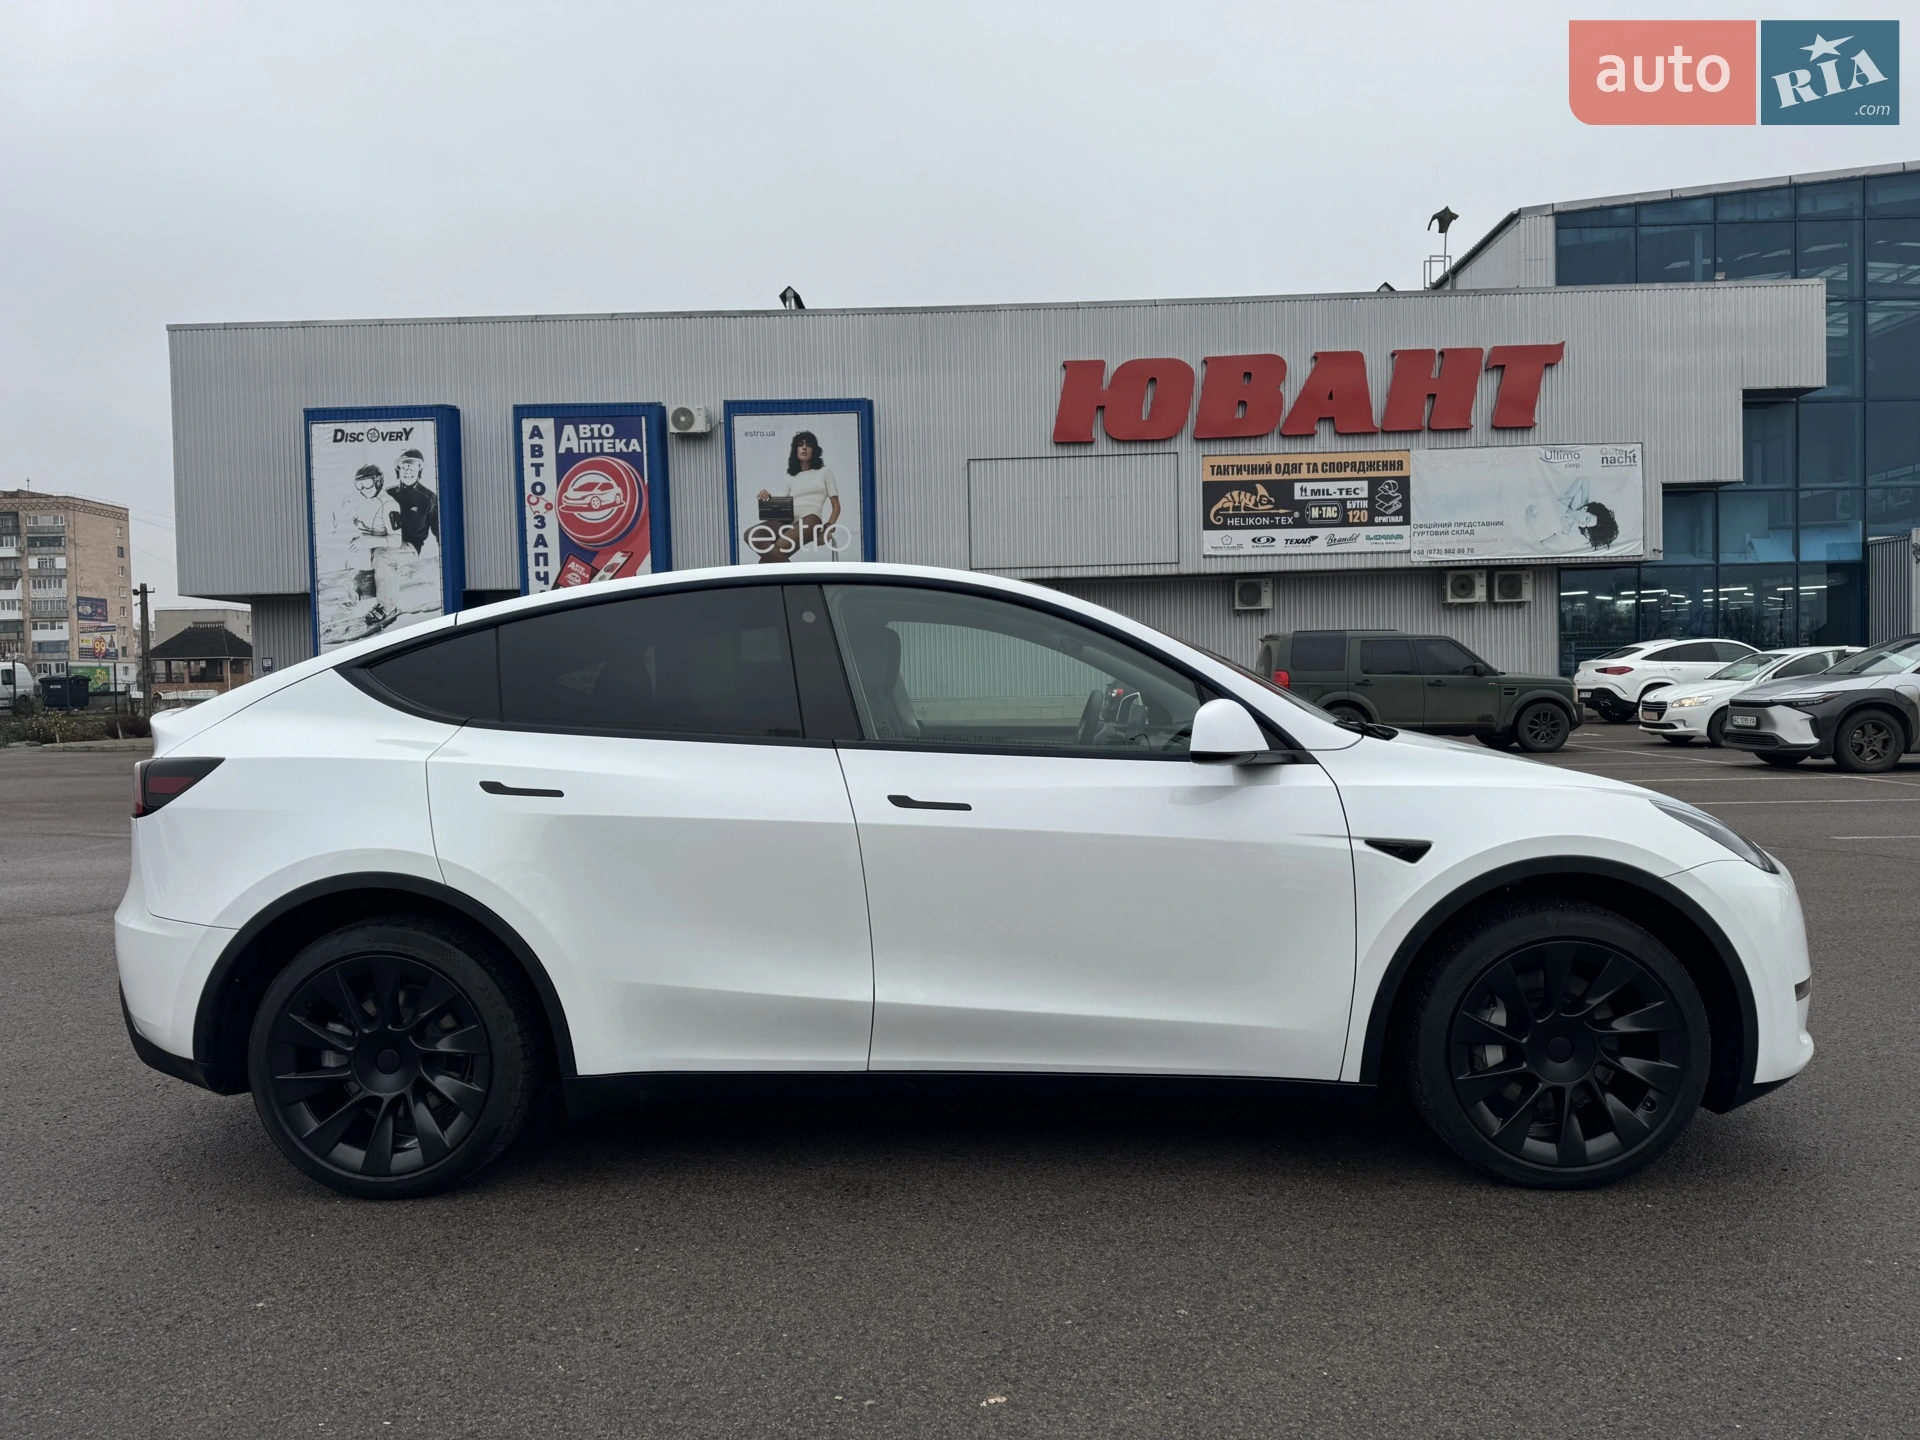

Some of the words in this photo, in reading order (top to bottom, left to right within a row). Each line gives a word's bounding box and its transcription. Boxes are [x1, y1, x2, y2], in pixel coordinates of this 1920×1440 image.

[1053, 341, 1566, 444] ЮВАНТ
[744, 430, 776, 438] estro.ua
[1544, 449, 1581, 461] Ultima
[1601, 449, 1637, 464] nacht
[1210, 461, 1272, 476] ТАКТИЧНИЙ
[1275, 462, 1303, 476] ОДЯГ
[1306, 462, 1319, 474] ТА
[1321, 460, 1404, 474] СПОРЯДЖЕННЯ
[1346, 500, 1369, 509] БУТІК
[1347, 509, 1369, 523] 120
[1374, 515, 1404, 524] ОРИГІНАЛ
[1412, 521, 1453, 530] ОФІЦІЙНИЙ
[1454, 520, 1505, 529] ПРЕДСТАВНИК
[747, 518, 851, 554] estro
[1412, 529, 1450, 537] ГУРТОВИЙ
[1451, 529, 1475, 537] СКЛАД
[94, 640, 106, 653] 99
